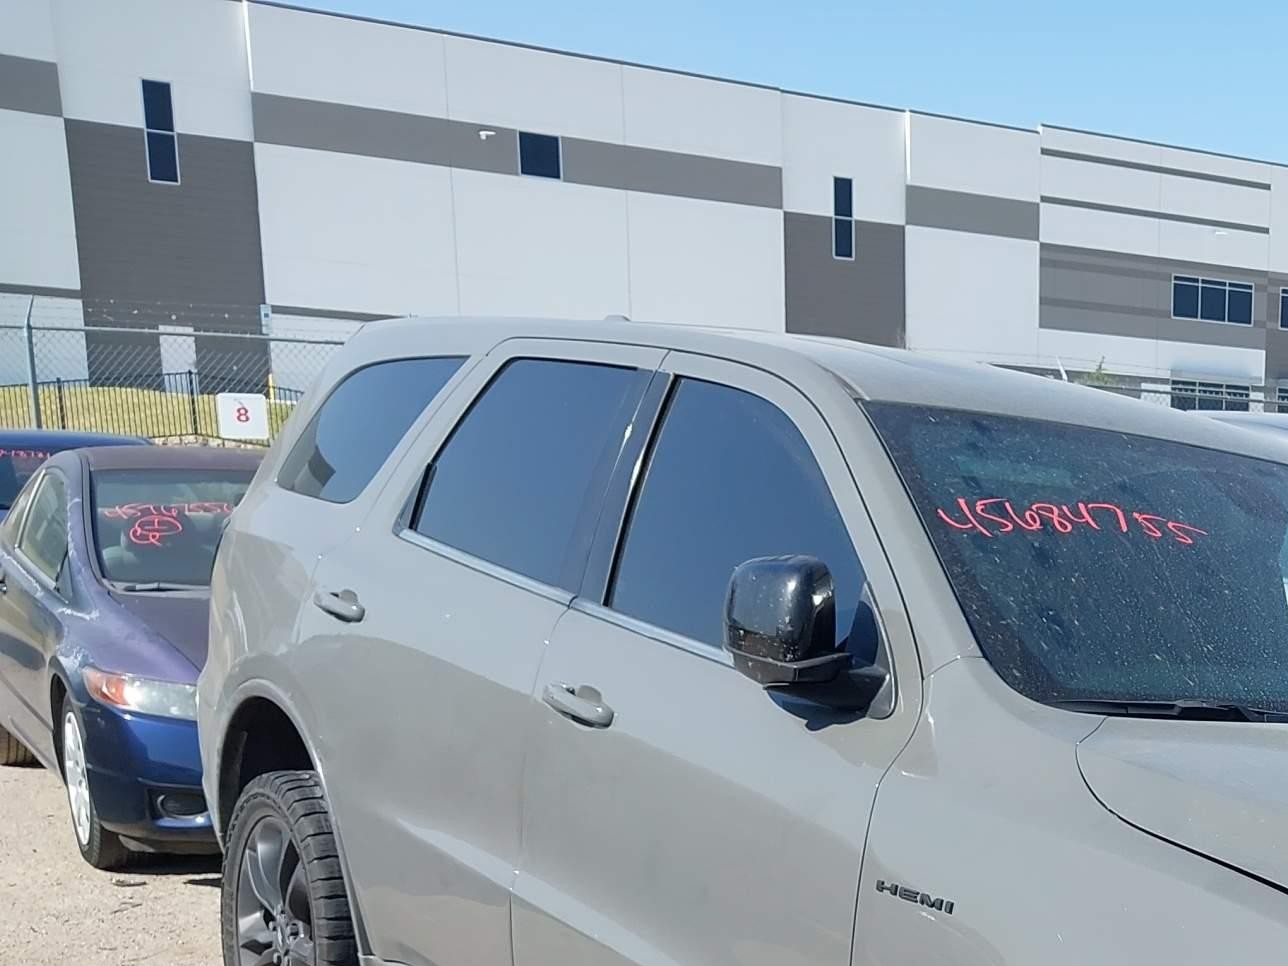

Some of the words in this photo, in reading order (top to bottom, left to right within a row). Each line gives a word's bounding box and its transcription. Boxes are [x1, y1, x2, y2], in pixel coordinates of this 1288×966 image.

[237, 407, 250, 422] 8
[937, 498, 1208, 544] 45684755
[876, 879, 955, 915] HEMI
